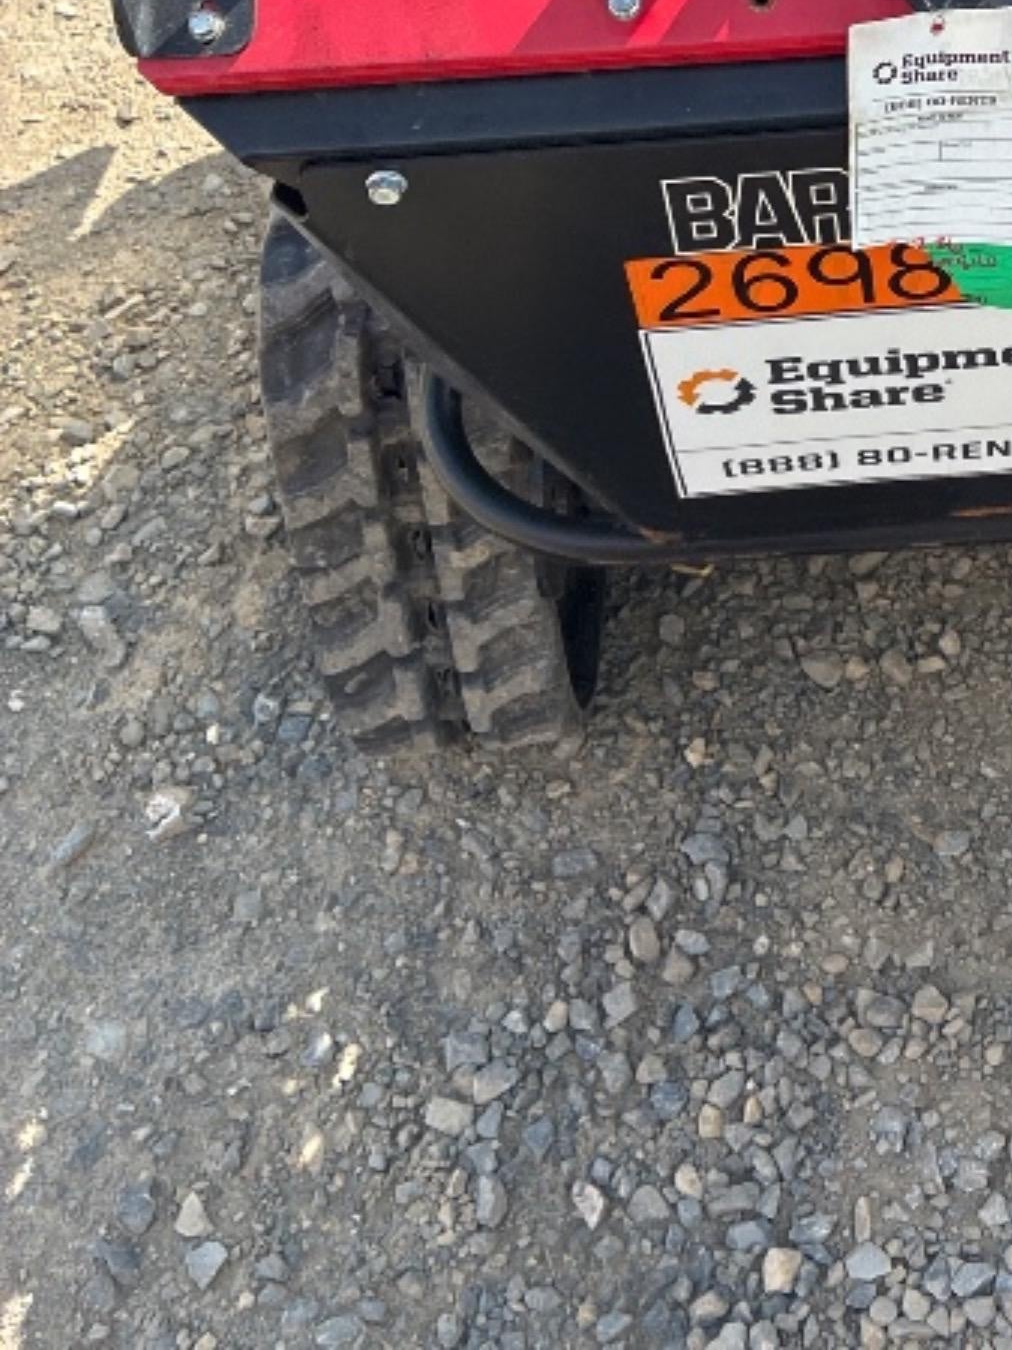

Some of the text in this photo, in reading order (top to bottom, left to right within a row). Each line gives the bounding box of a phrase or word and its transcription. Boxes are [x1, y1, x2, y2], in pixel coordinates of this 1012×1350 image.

[901, 50, 1011, 70] Equipment
[901, 68, 958, 85] Share
[769, 381, 945, 415] Share
[722, 450, 840, 479] (888)
